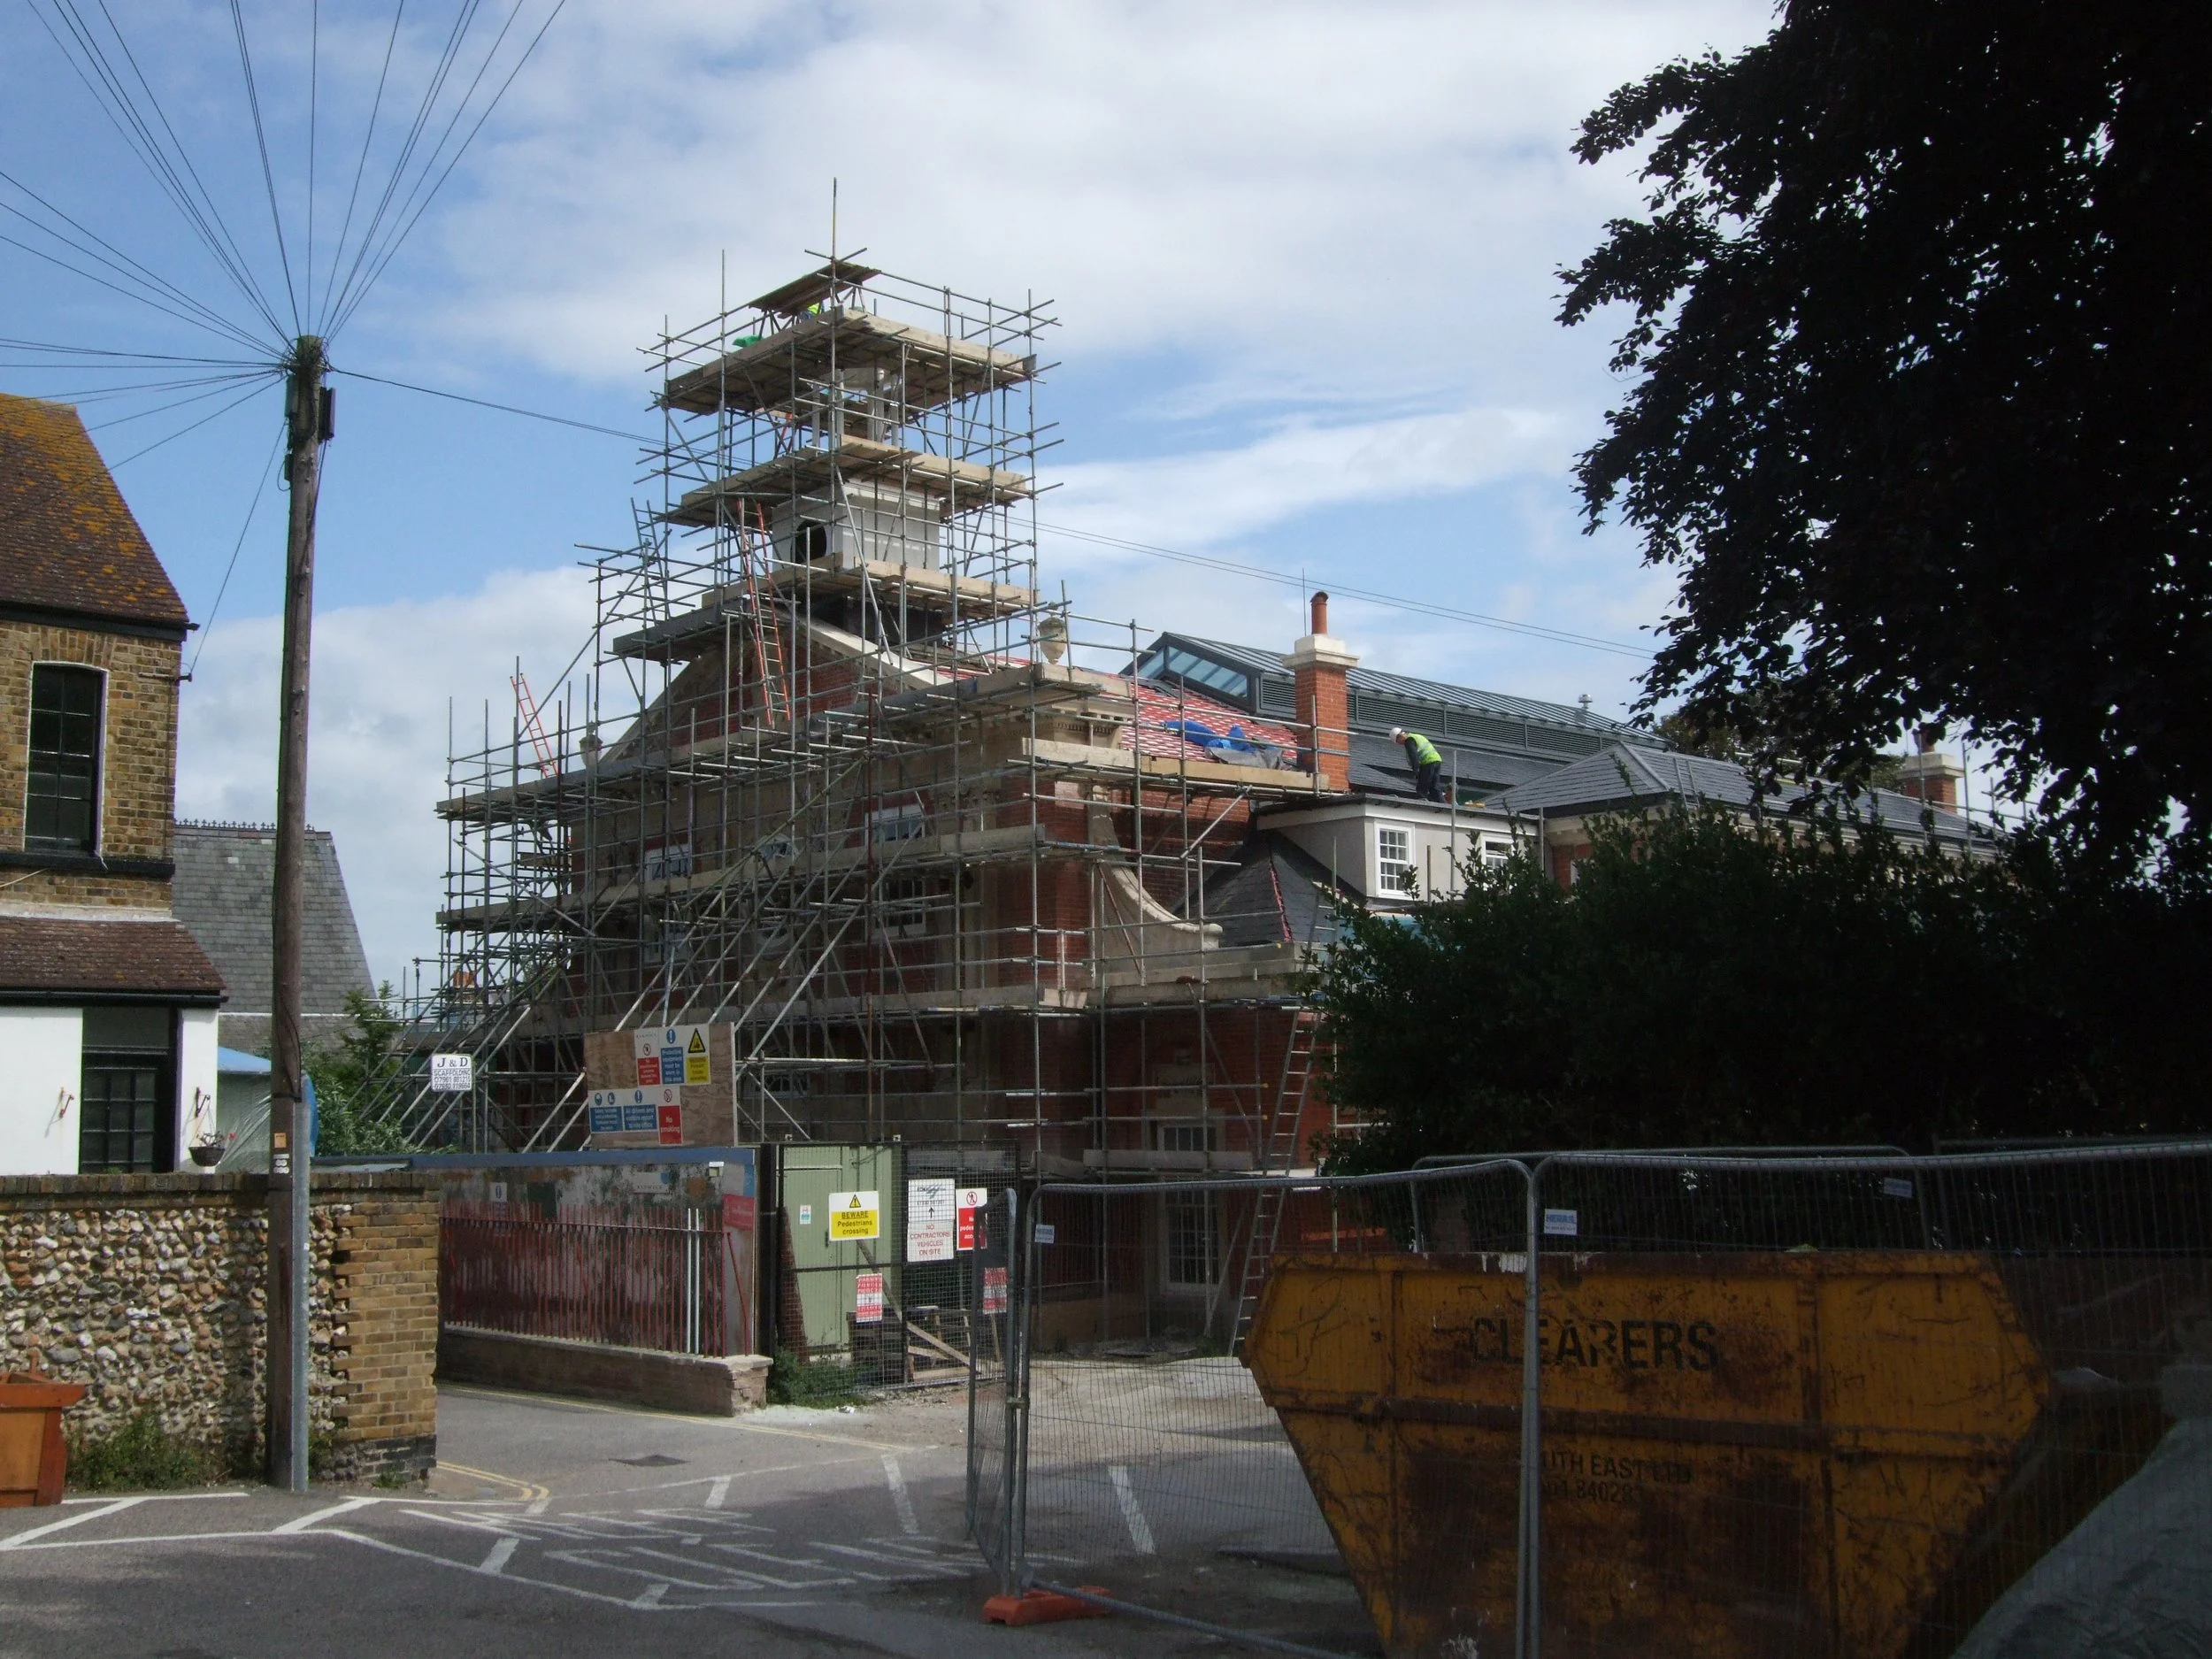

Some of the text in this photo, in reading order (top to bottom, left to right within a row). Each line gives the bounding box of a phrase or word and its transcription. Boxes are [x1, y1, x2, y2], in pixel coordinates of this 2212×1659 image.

[437, 1057, 468, 1068] J & D
[841, 1210, 869, 1219] BEWARE
[910, 1231, 951, 1240] CONTRACTORS
[1472, 1317, 1721, 1372] CLEARERS
[1541, 1448, 1585, 1475] UTH
[1590, 1452, 1645, 1484] EAST
[400, 1507, 778, 1540] KEEP
